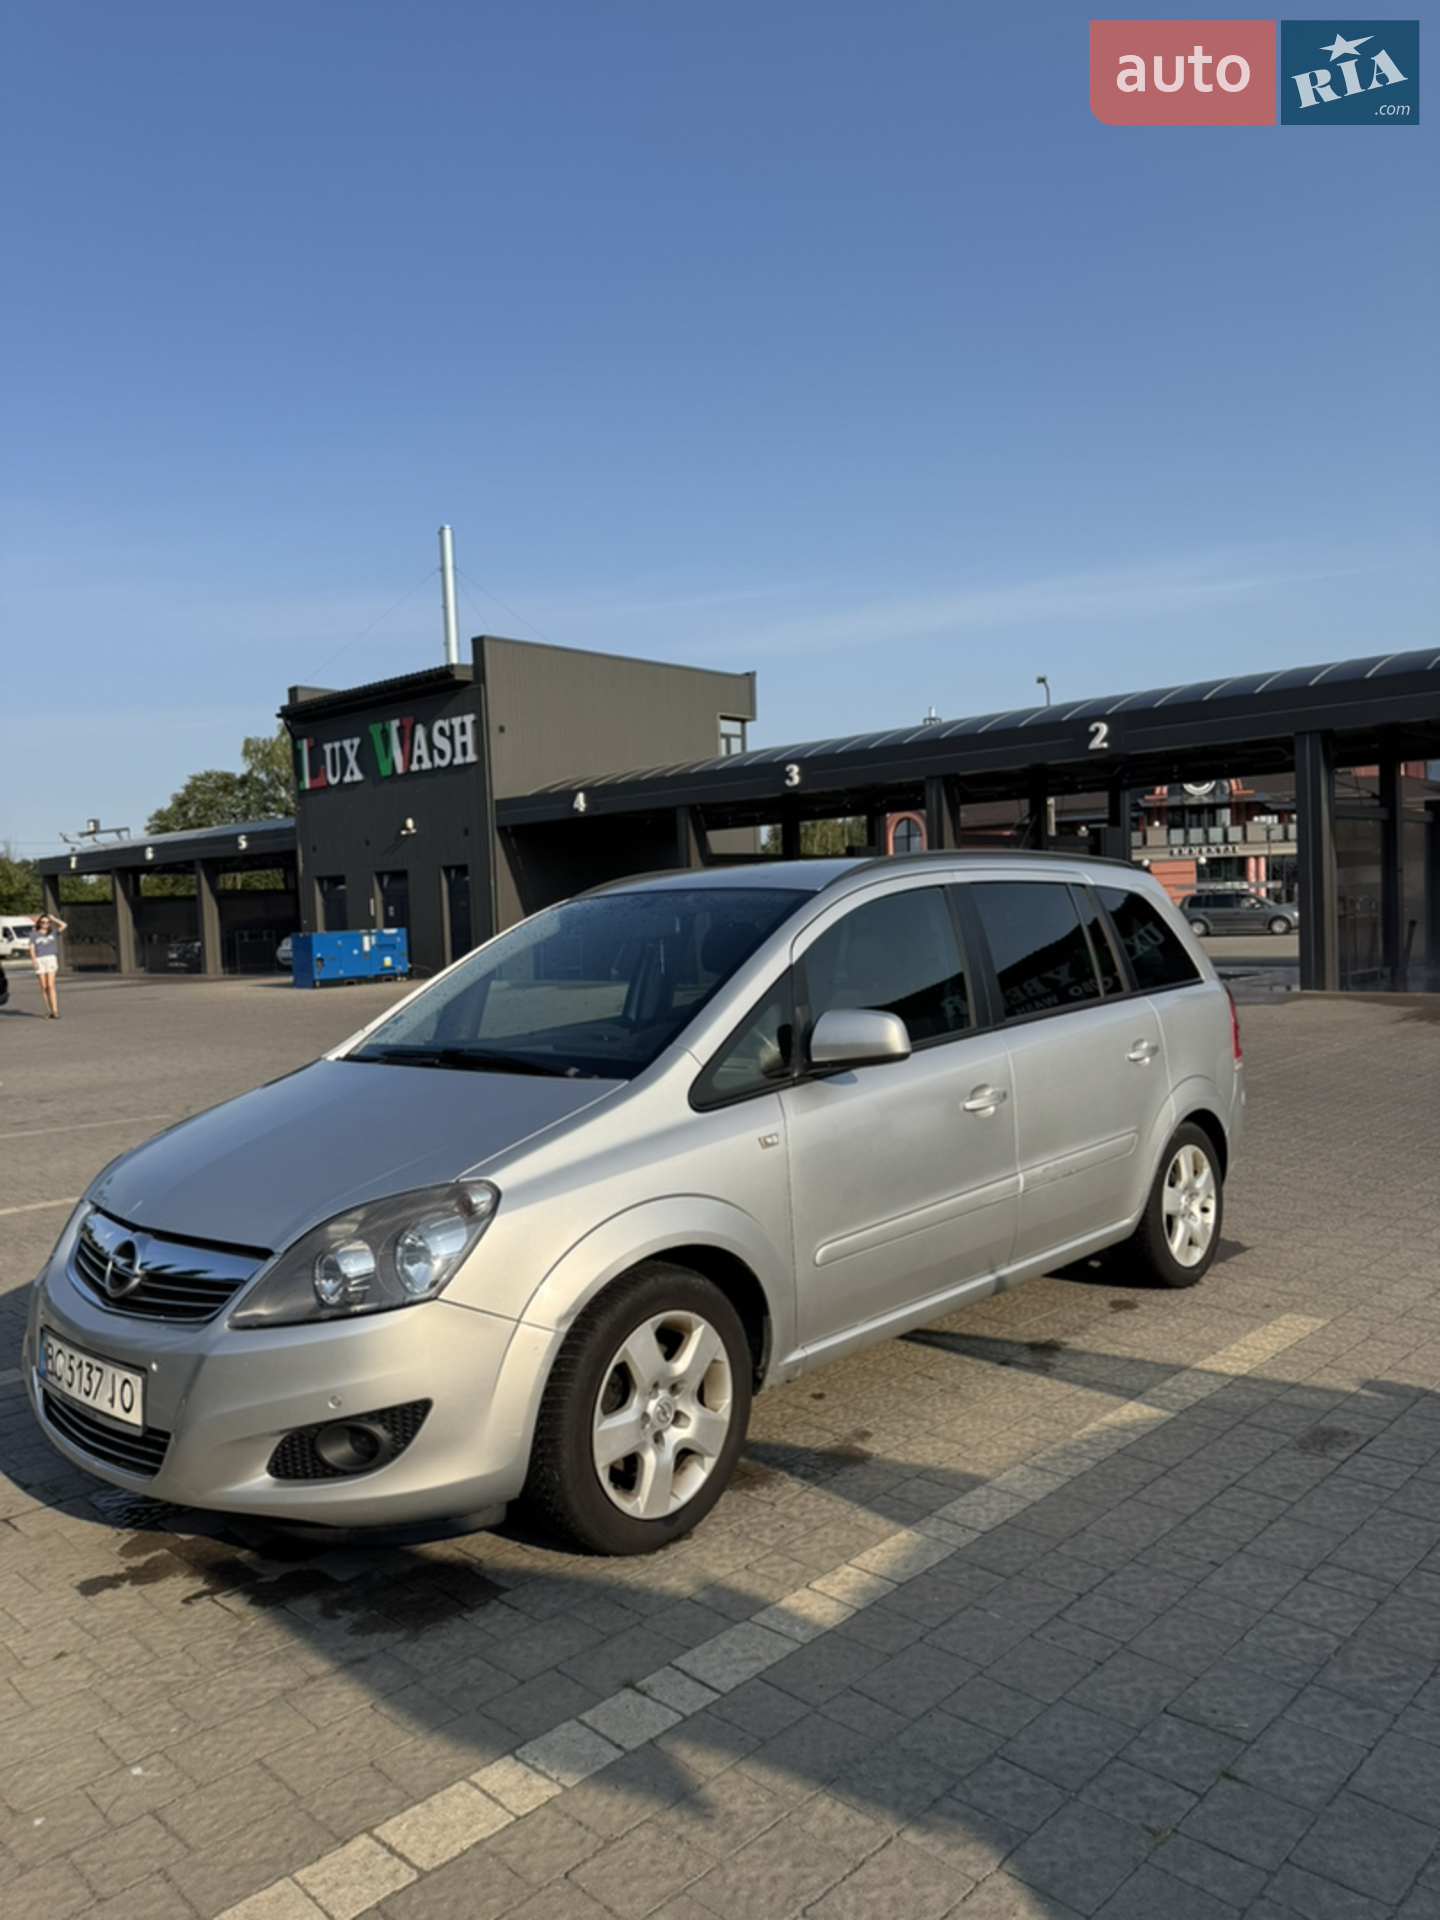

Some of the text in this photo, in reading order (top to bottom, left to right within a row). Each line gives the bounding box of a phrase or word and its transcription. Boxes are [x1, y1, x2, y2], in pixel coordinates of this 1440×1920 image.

[1087, 721, 1109, 750] 2
[297, 713, 478, 790] LUX WASH
[784, 764, 800, 787] 3
[572, 792, 587, 813] 4
[237, 834, 248, 850] 5
[145, 846, 154, 861] 6
